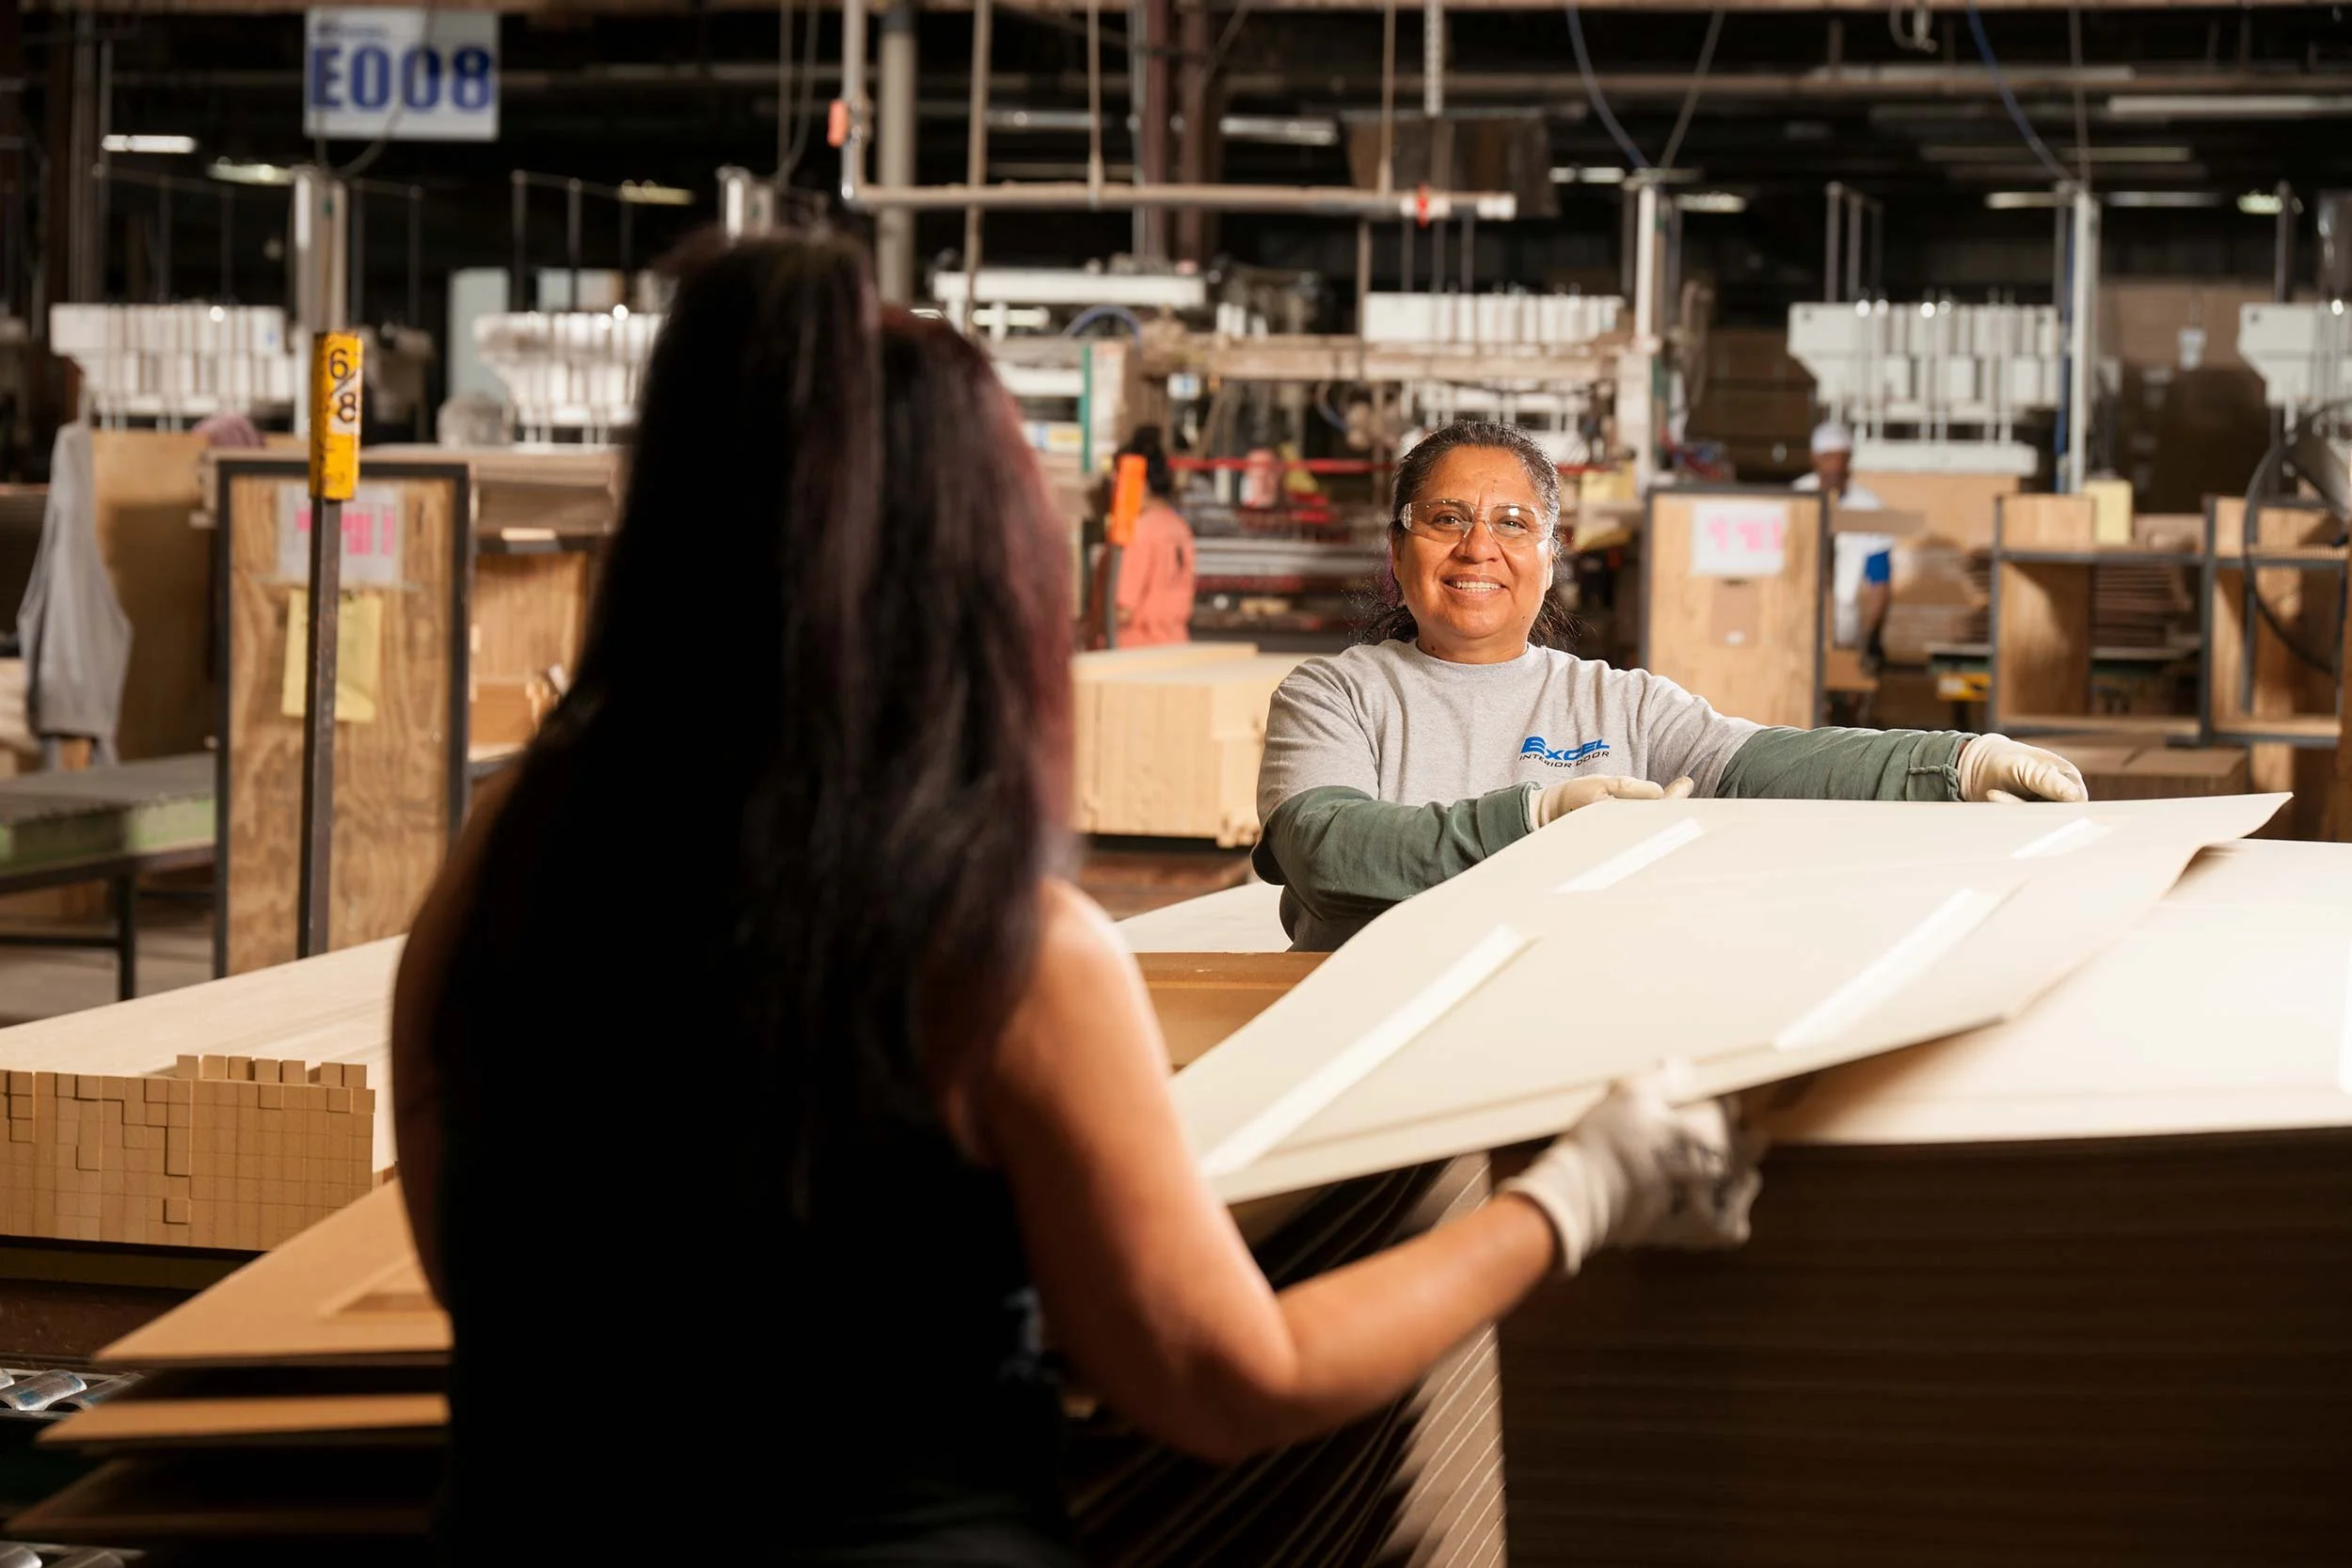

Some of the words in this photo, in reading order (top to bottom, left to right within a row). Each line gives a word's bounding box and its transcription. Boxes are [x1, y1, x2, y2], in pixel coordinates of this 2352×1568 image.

[311, 45, 492, 112] E008
[1518, 753, 1572, 768] INTERIOR
[1575, 751, 1610, 767] DOOR
[1520, 736, 1610, 761] EXCEL
